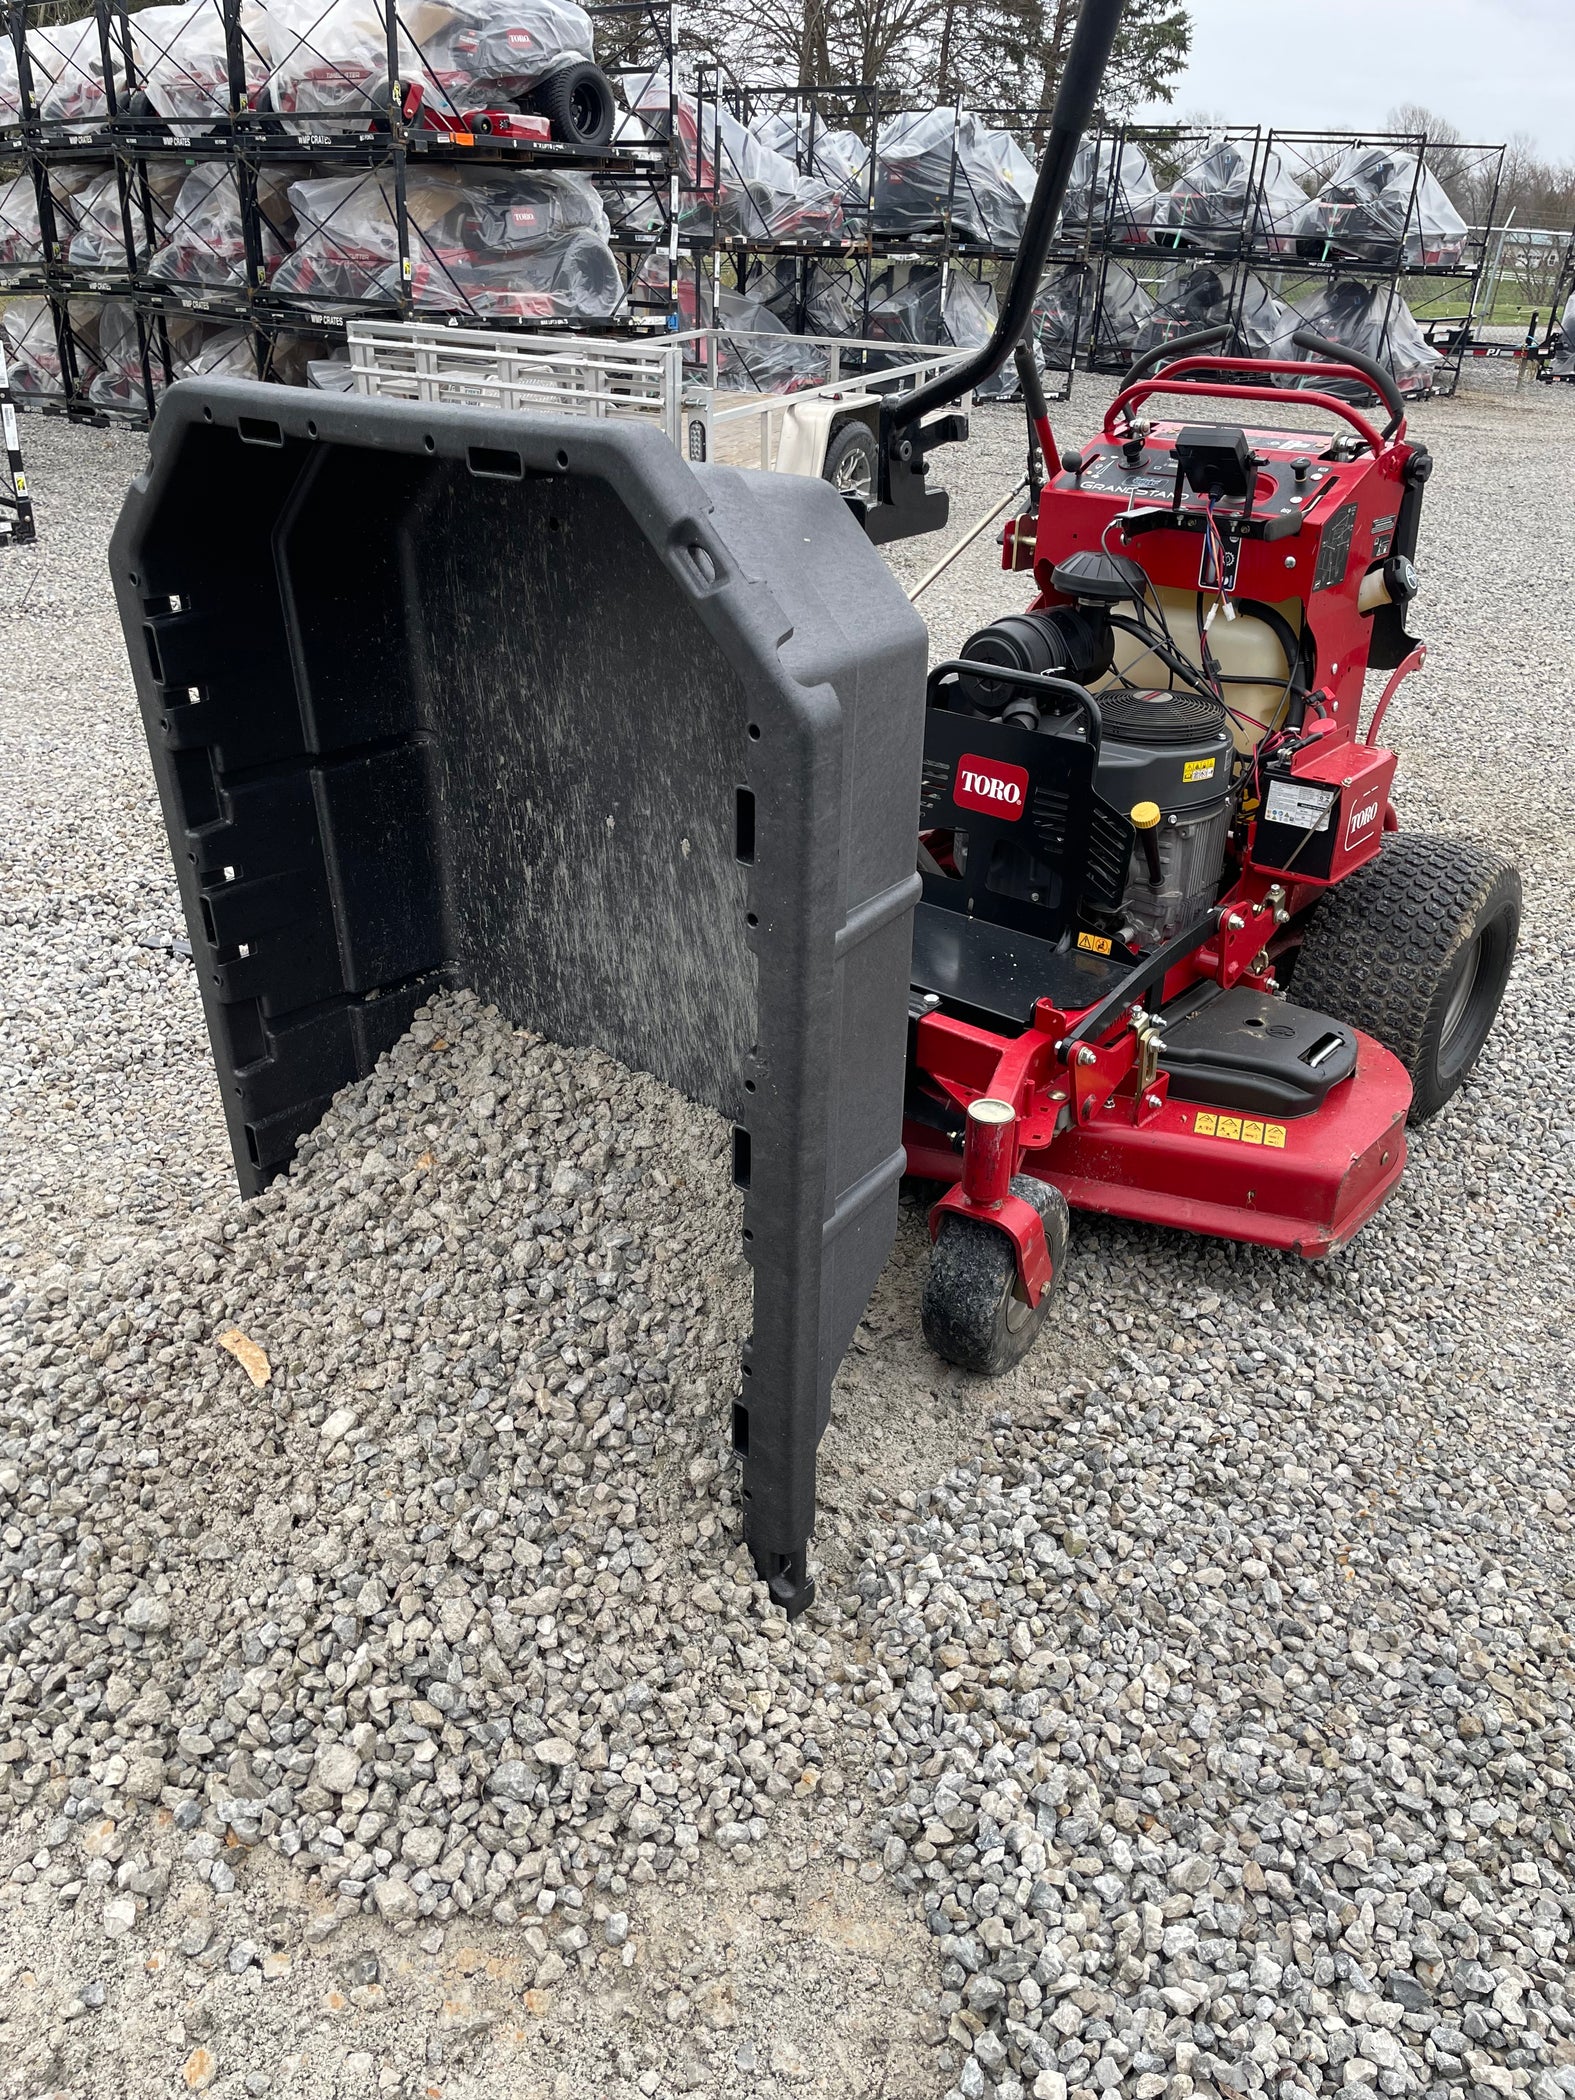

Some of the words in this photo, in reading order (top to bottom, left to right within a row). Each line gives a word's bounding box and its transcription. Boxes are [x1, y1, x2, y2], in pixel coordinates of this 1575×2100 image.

[508, 34, 530, 43] TORO
[174, 137, 191, 147] CRATES
[311, 135, 332, 145] CRATES
[513, 212, 535, 221] TORO
[192, 301, 210, 311] CRATES
[311, 314, 323, 324] WMP
[323, 315, 344, 326] CRATES
[1486, 348, 1501, 357] PJ
[961, 770, 1021, 804] TORO
[1350, 801, 1378, 834] TORO
